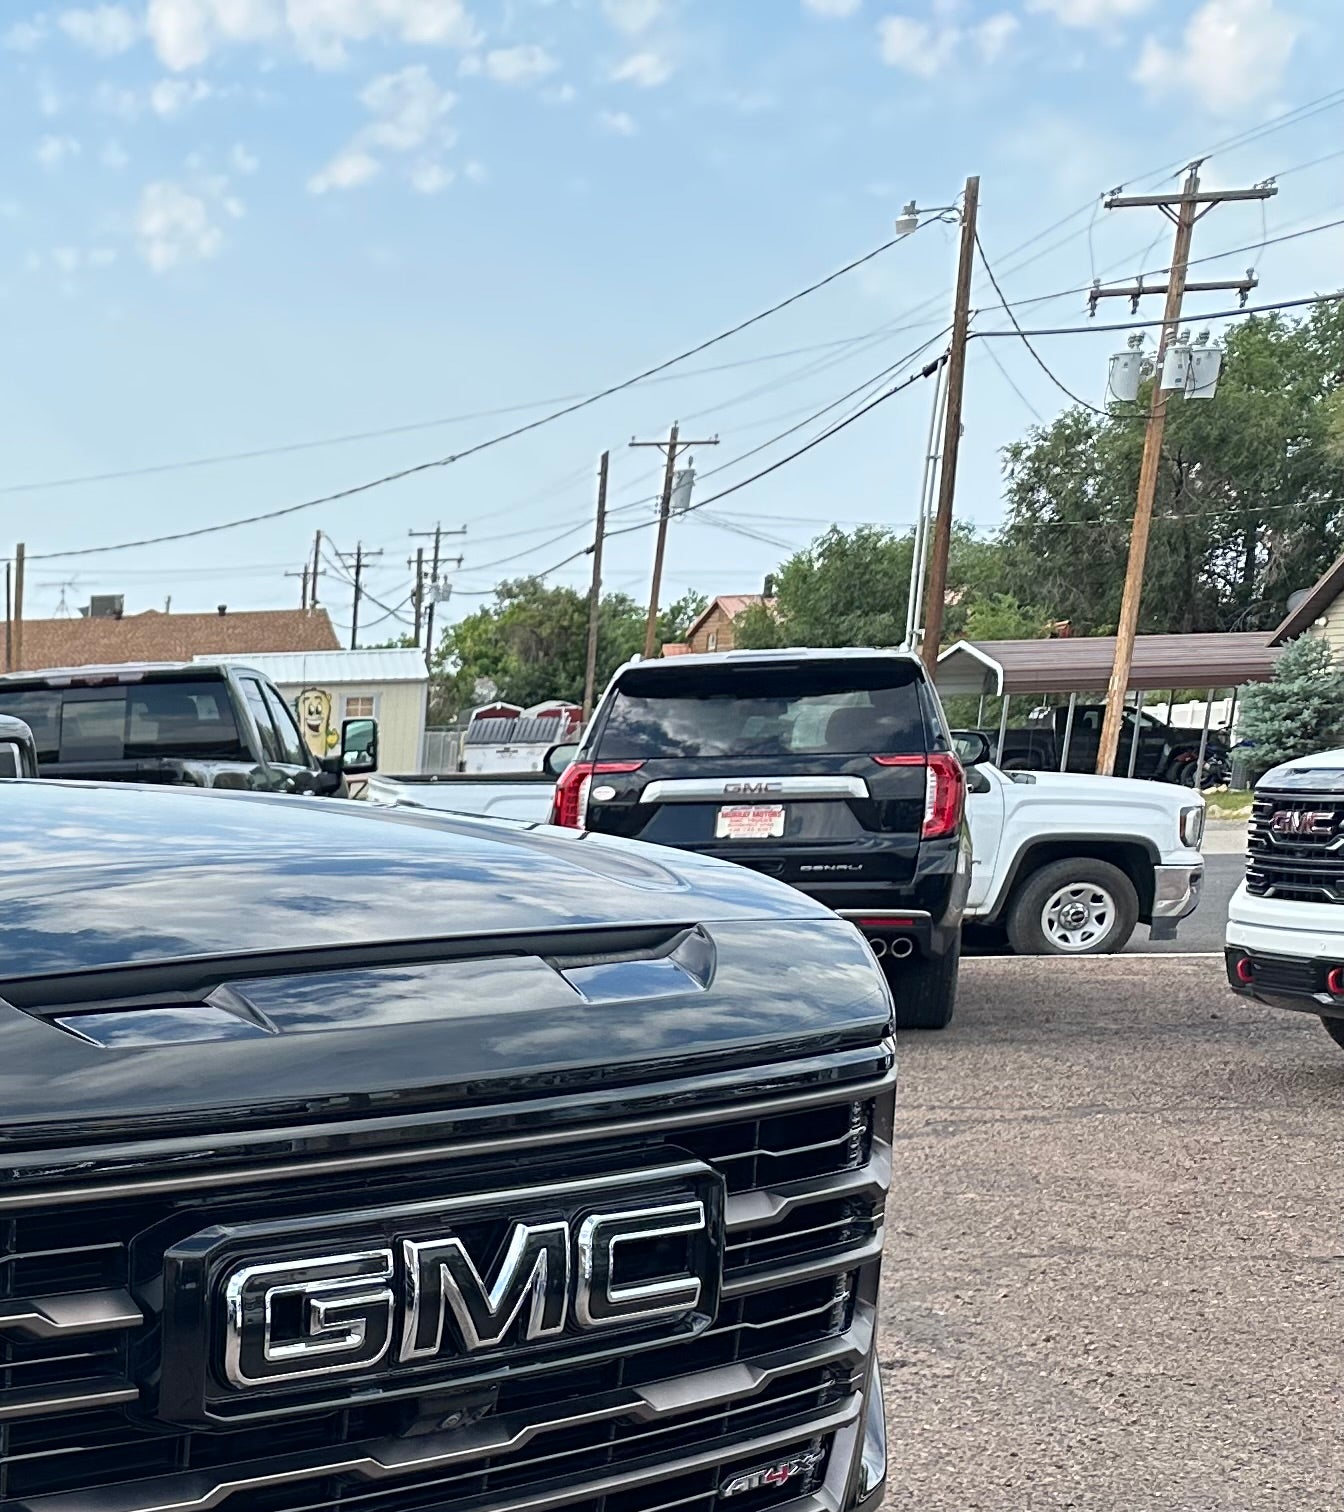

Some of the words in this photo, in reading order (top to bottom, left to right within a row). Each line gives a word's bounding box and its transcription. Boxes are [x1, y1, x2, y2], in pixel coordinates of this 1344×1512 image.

[723, 782, 782, 794] GMC
[1271, 810, 1335, 834] GMC
[224, 1200, 706, 1389] GMC
[723, 1451, 825, 1498] AT4X
